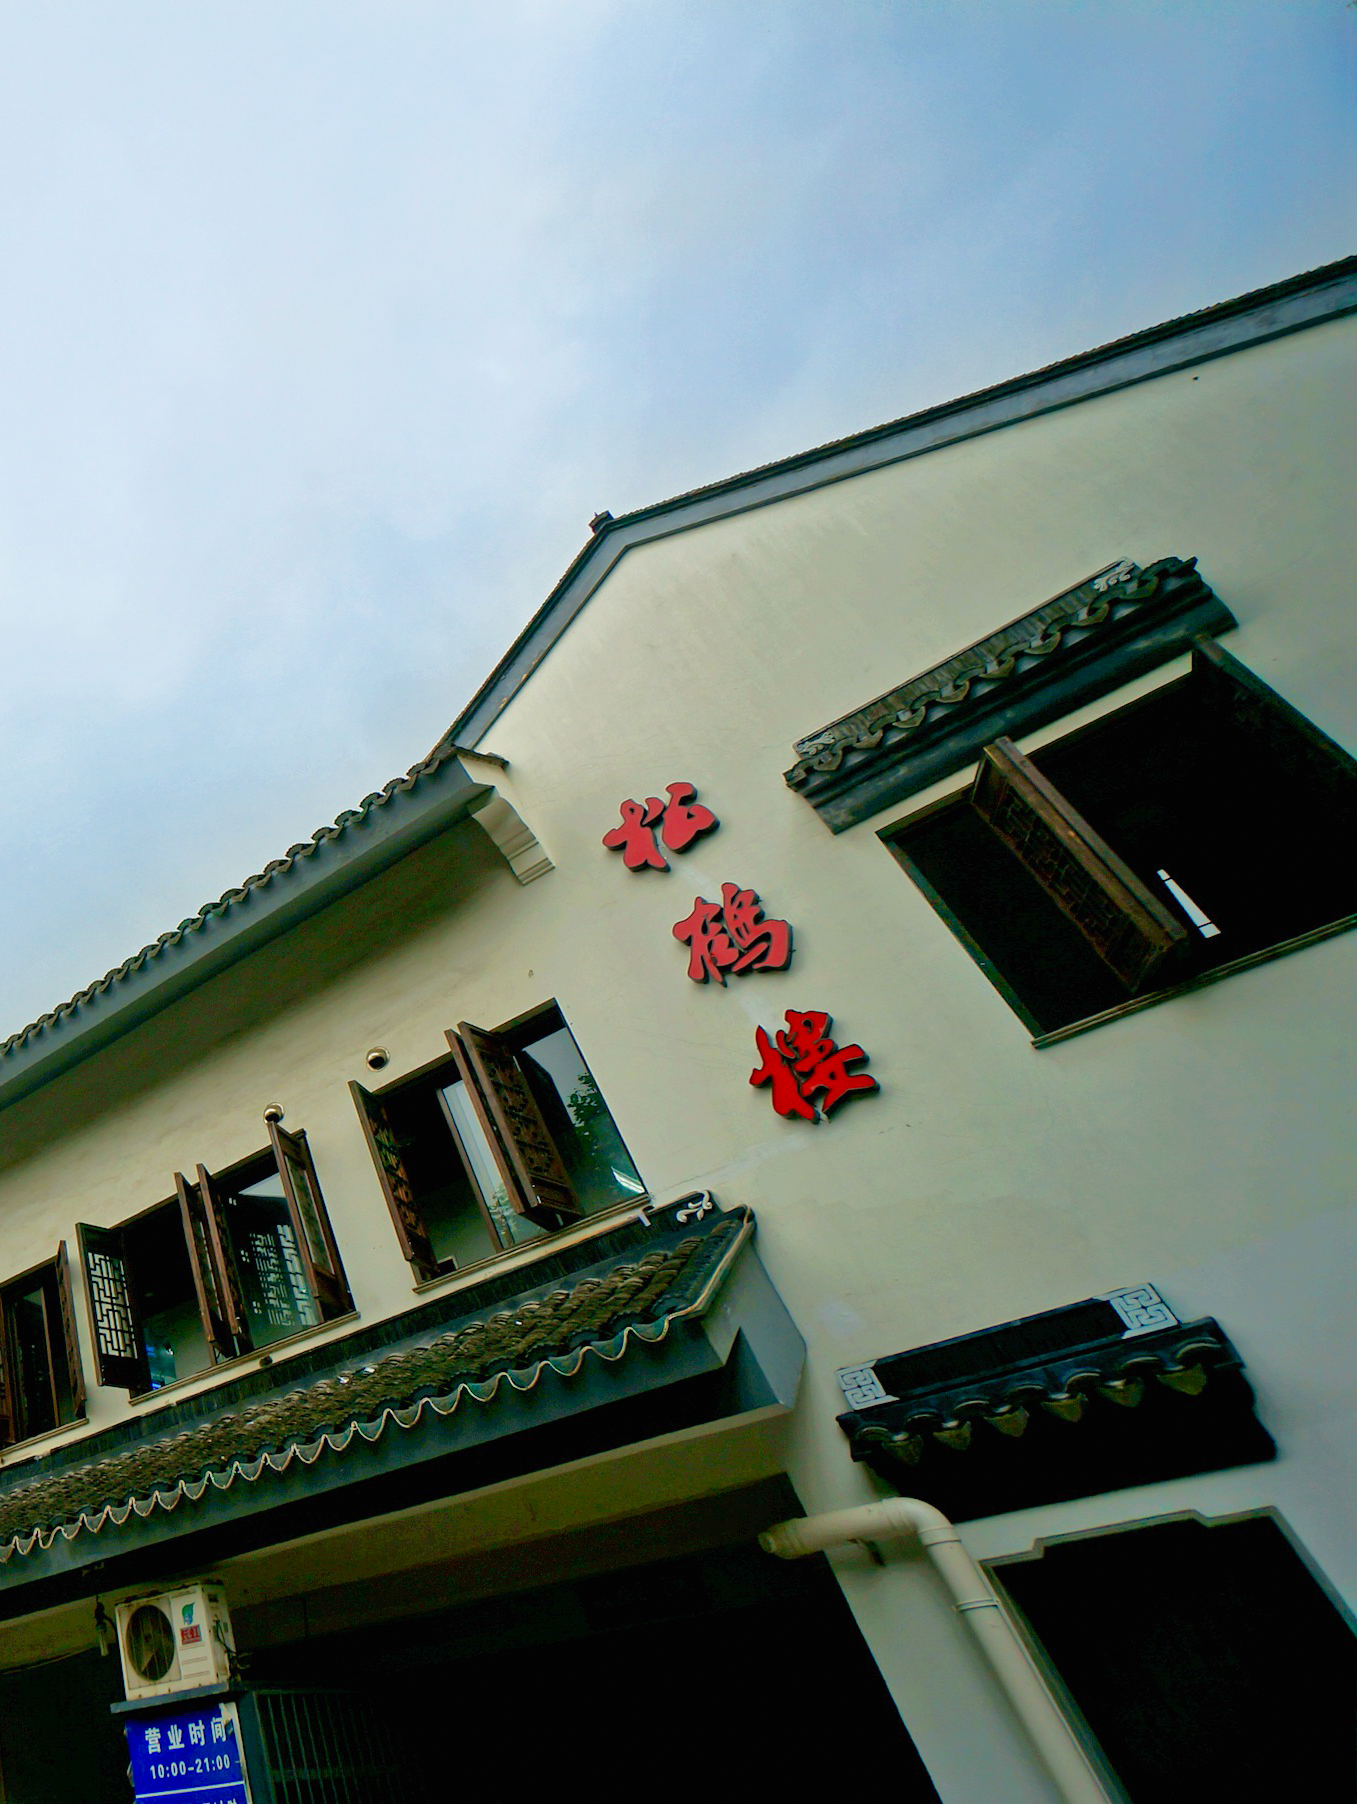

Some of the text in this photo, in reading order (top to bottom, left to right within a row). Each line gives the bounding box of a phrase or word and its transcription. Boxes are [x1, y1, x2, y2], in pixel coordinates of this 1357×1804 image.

[144, 1717, 227, 1754] 营业时间
[150, 1754, 230, 1779] 10:00-21:00
